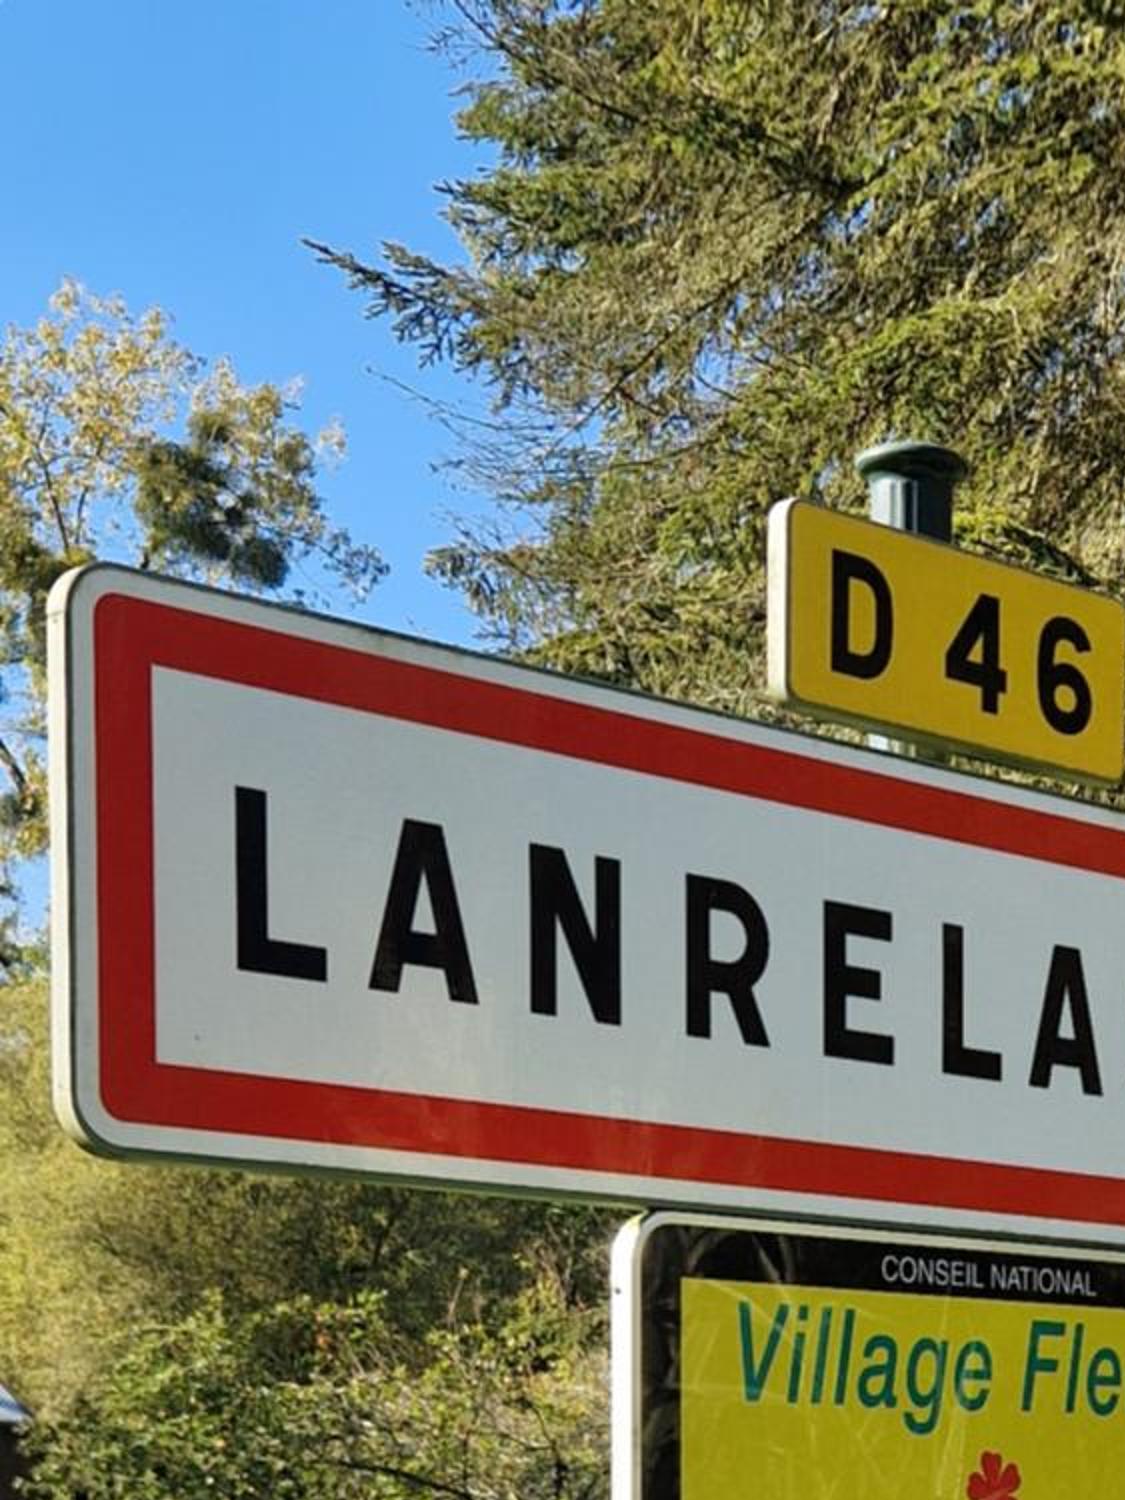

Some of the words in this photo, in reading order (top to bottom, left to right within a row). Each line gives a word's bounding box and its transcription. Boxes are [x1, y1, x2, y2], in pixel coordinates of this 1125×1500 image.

[830, 549, 894, 680] D
[944, 593, 1094, 737] 46
[880, 1254, 984, 1289] CONSEIL
[989, 1263, 1097, 1297] NATIONAL
[737, 1300, 994, 1437] Village
